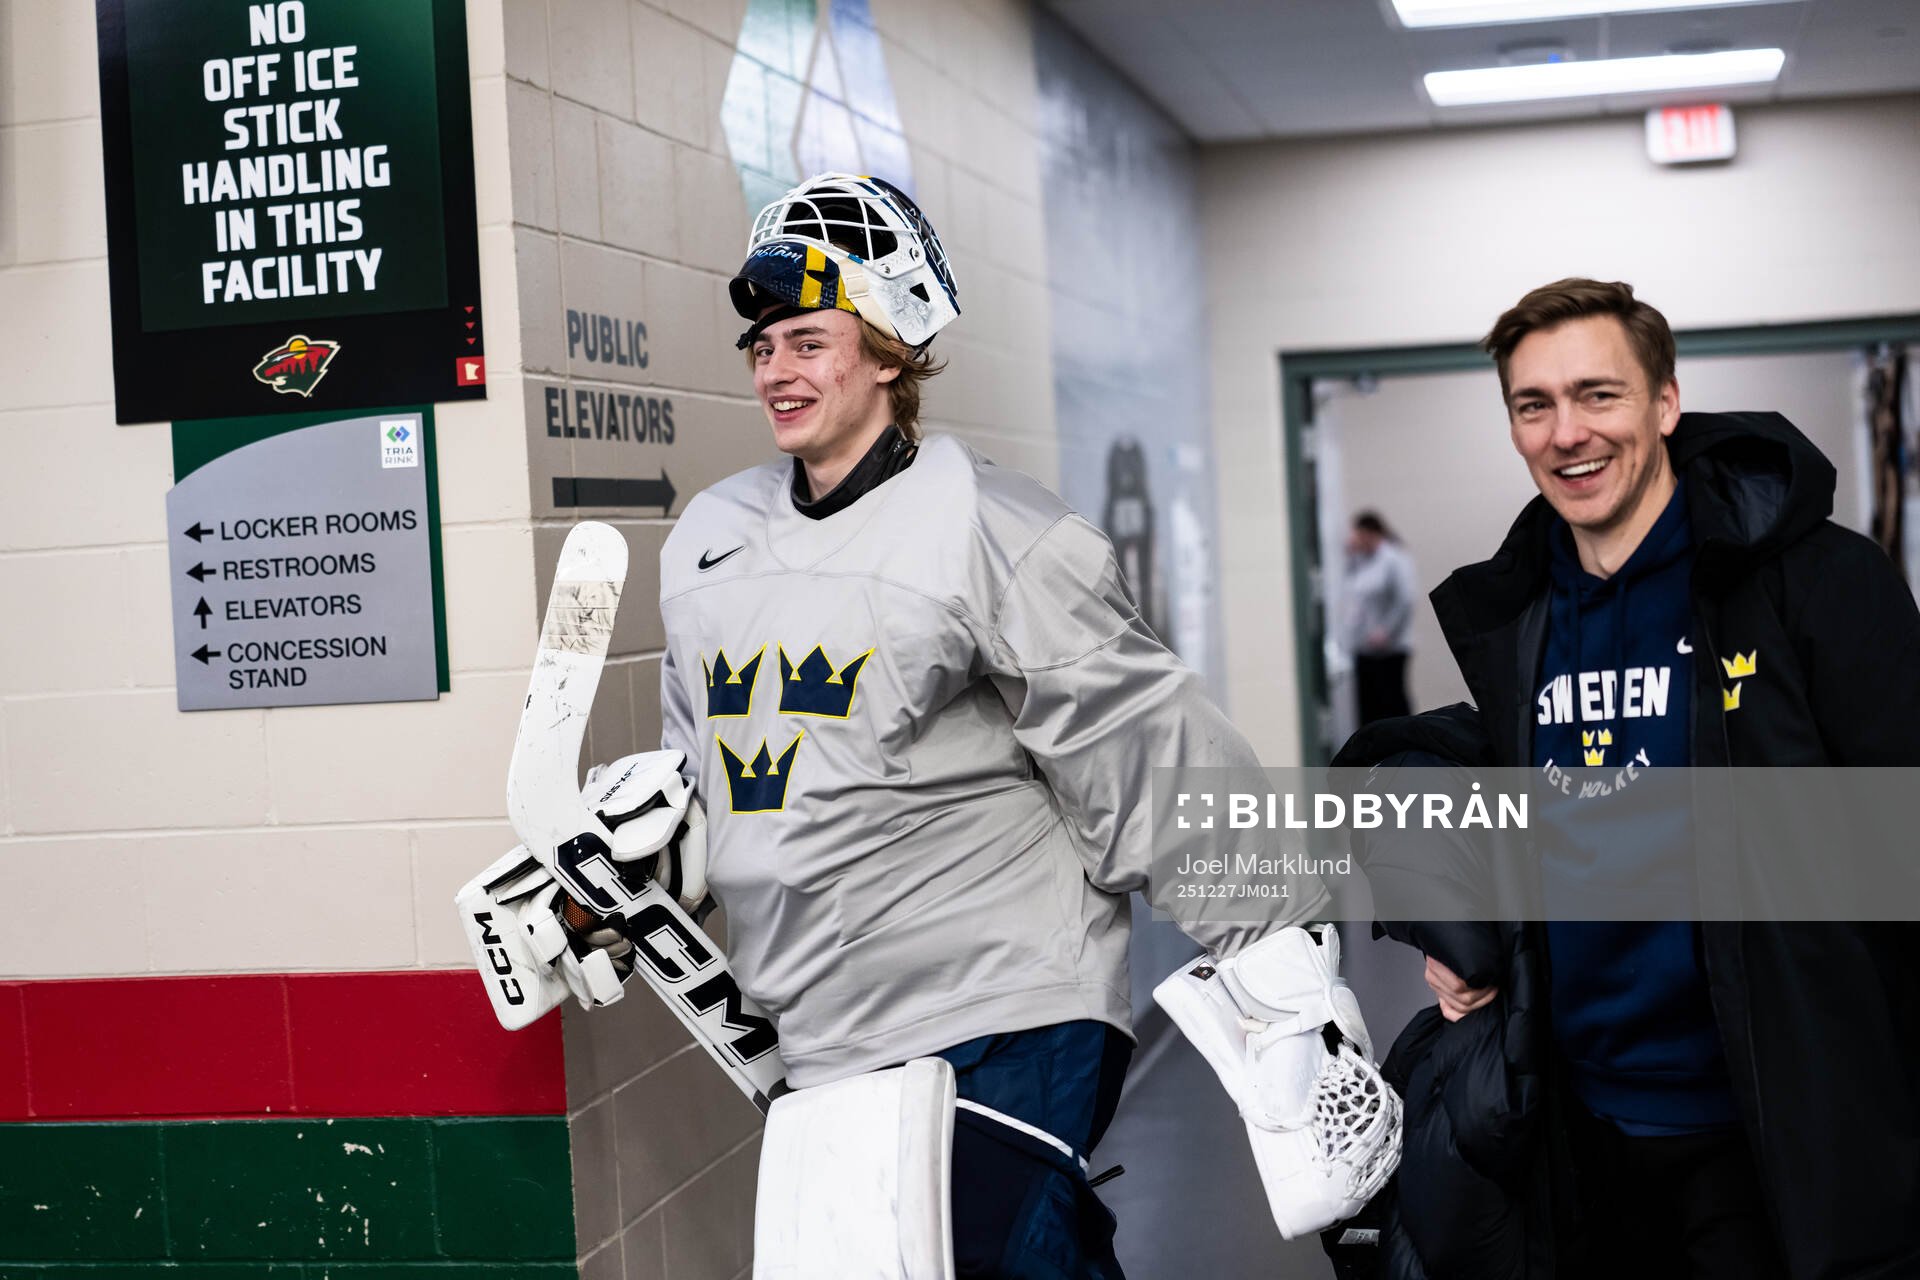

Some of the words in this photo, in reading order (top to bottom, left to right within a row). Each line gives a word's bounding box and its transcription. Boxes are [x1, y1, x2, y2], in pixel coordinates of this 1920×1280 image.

[248, 0, 306, 46] NO
[203, 53, 281, 102] OFF
[293, 45, 359, 93] ICE
[223, 98, 343, 151] STICK
[182, 145, 391, 205] HANDLING
[214, 207, 256, 252] IN
[267, 198, 363, 247] THIS
[202, 248, 383, 304] FACILITY
[566, 309, 649, 370] PUBLIC
[544, 387, 676, 446] ELEVATORS
[384, 446, 414, 455] TRIA
[384, 455, 414, 465] RINK
[220, 516, 318, 541] LOCKER
[325, 509, 418, 534] ROOMS
[223, 553, 376, 581] RESTROOMS
[225, 594, 362, 621] ELEVATORS
[227, 636, 387, 663] CONCESSION
[228, 666, 307, 690] STAND
[1537, 666, 1671, 725] SWEDEN
[1542, 758, 1573, 796] ICE
[473, 911, 525, 1006] CCM
[553, 831, 780, 1066] CCM
